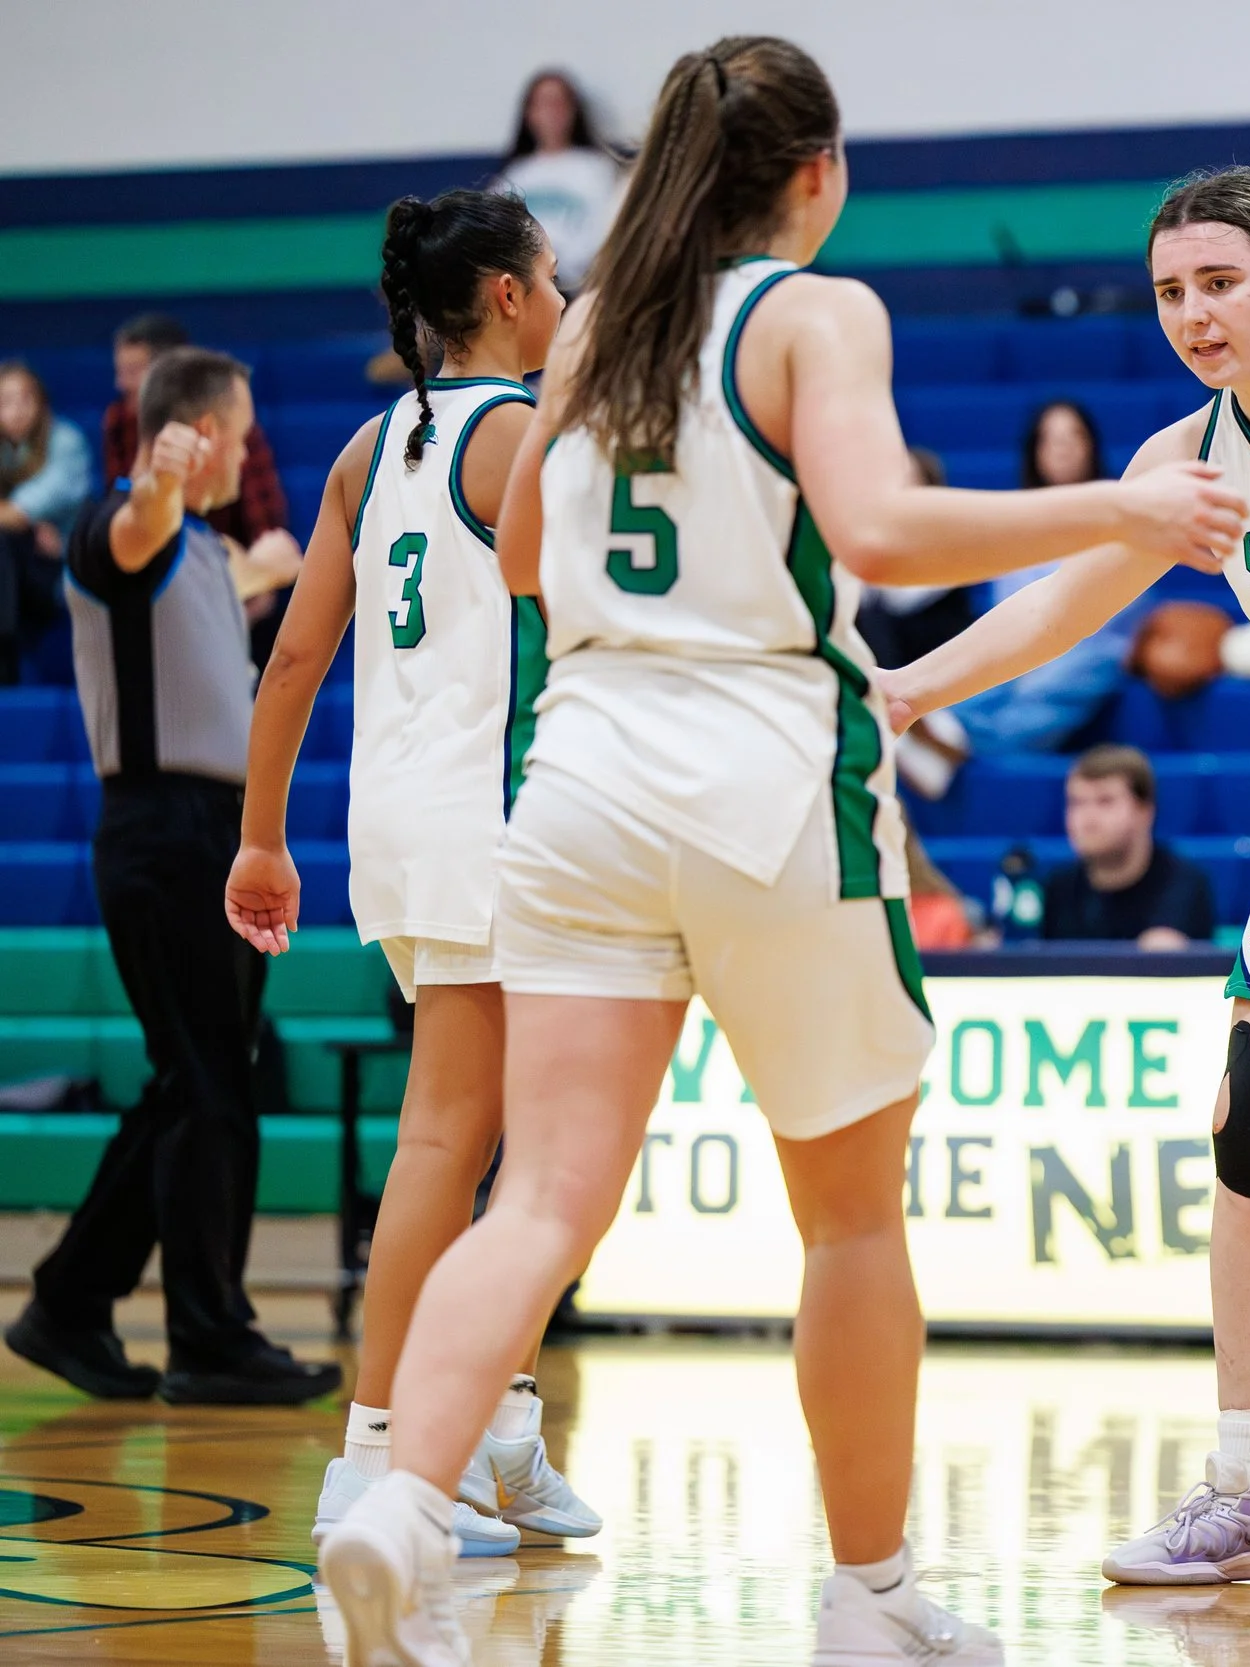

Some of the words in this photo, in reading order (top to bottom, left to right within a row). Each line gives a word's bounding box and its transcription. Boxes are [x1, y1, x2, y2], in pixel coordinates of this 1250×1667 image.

[605, 446, 680, 597] 5
[388, 531, 428, 650] 3
[635, 1133, 739, 1213] TO
[1029, 1138, 1212, 1265] NE
